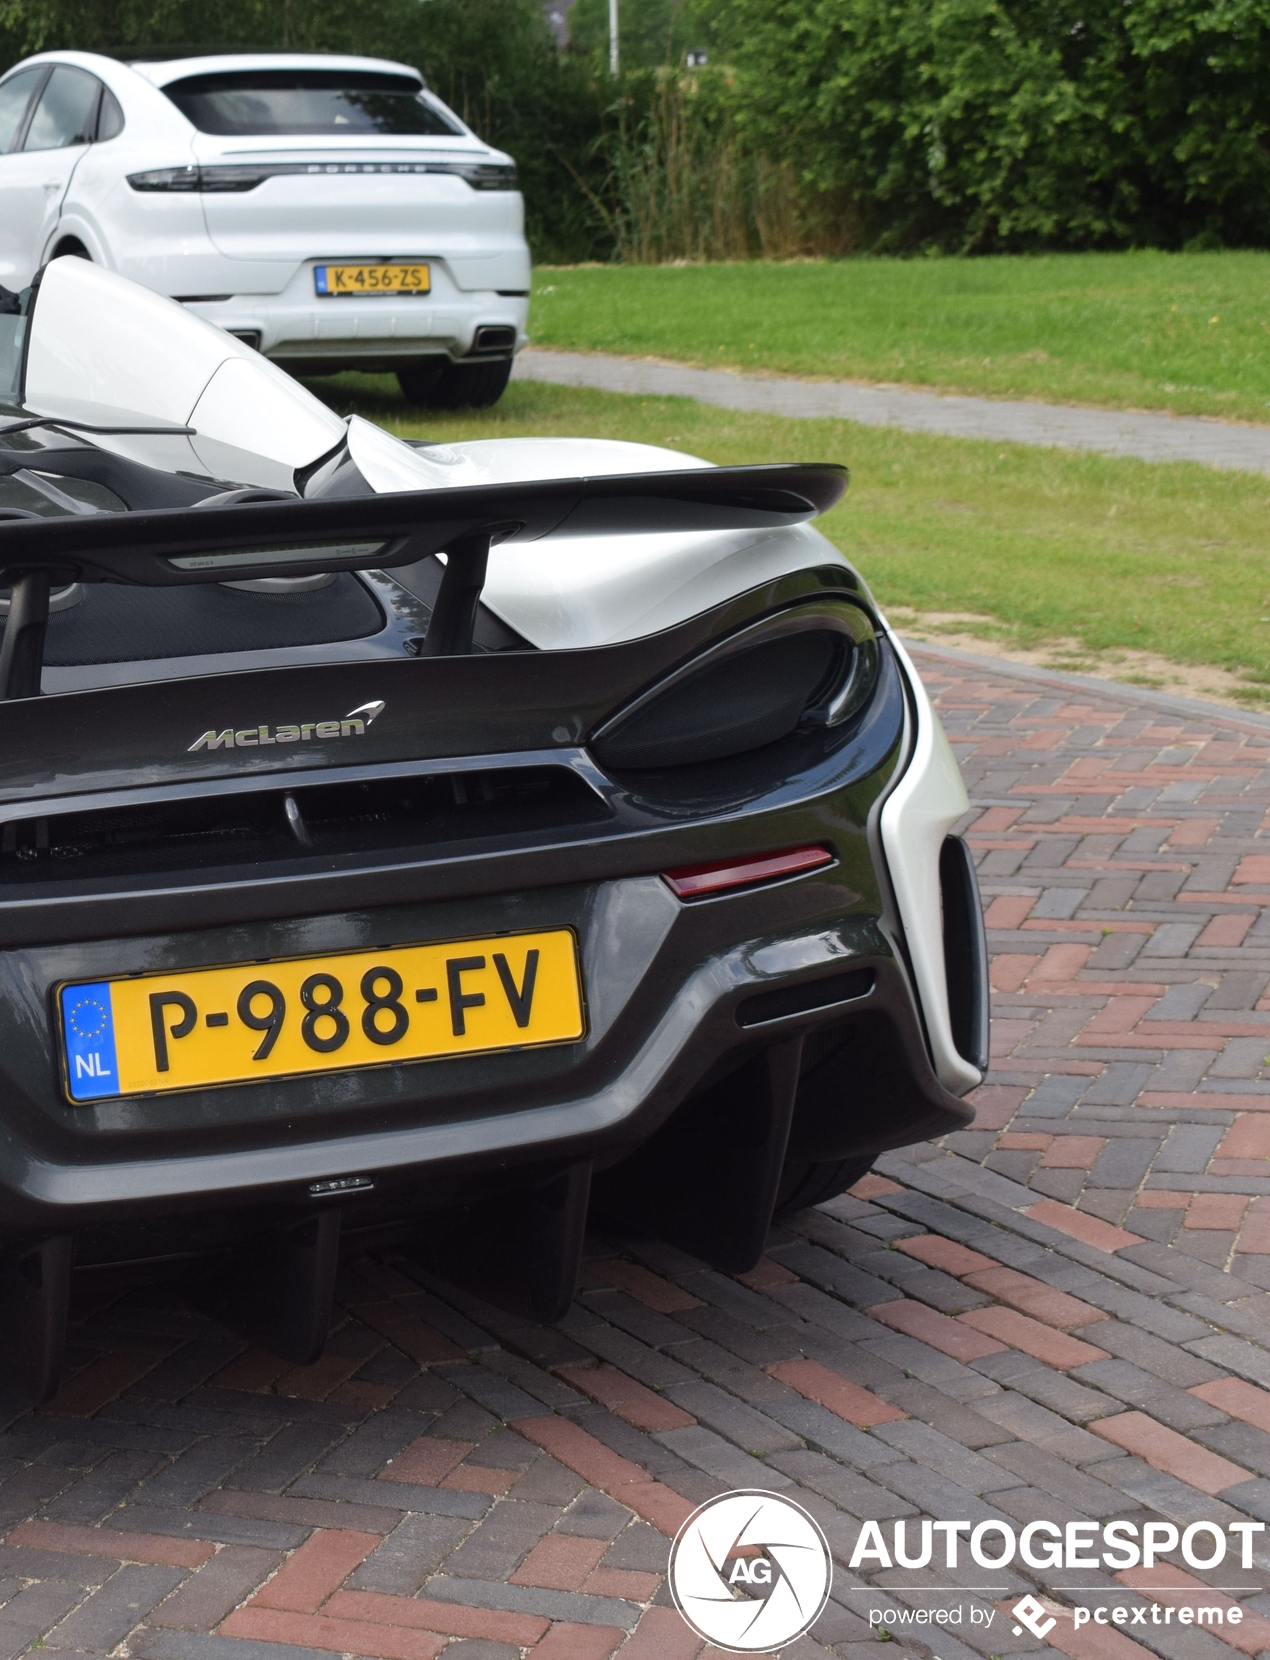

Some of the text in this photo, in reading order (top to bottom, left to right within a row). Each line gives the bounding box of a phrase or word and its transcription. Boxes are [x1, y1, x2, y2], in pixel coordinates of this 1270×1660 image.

[334, 268, 422, 288] K-456-ZS
[187, 718, 366, 752] McLaren
[148, 948, 540, 1073] P-988-FV
[75, 1052, 111, 1079] NL
